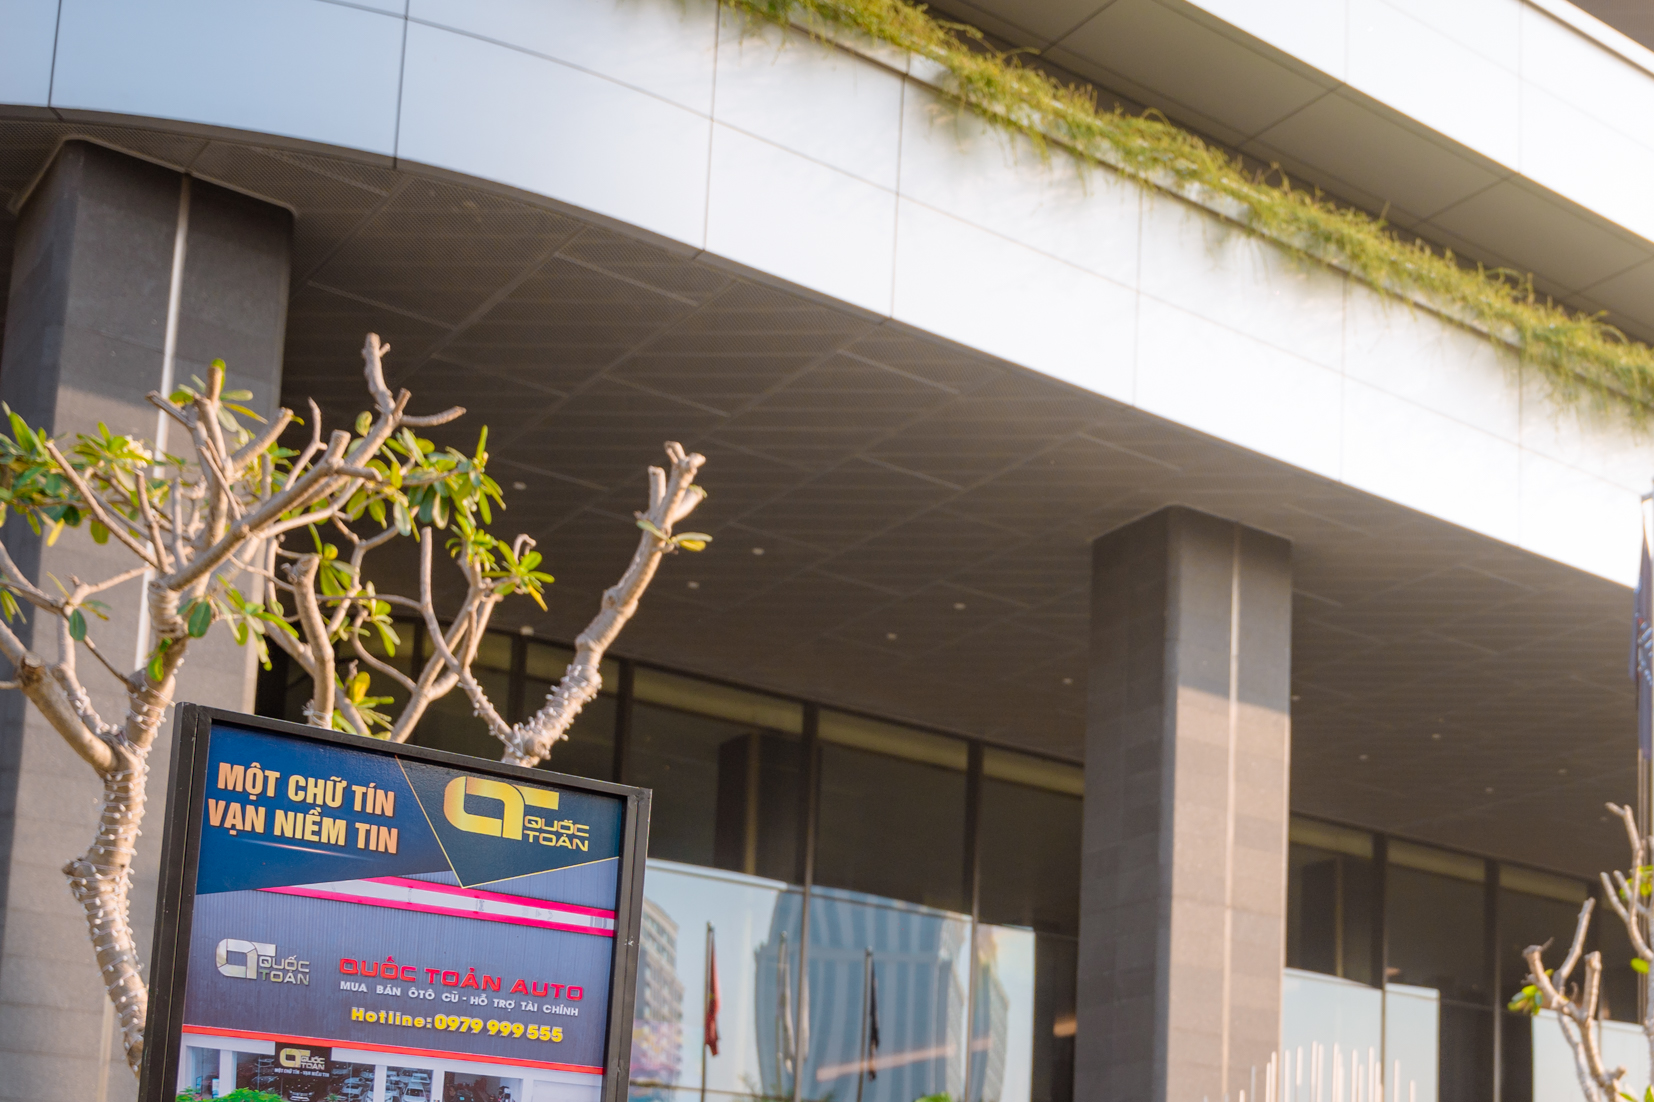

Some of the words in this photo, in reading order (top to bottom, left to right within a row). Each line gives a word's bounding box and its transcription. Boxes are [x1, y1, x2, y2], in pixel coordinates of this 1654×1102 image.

[217, 762, 280, 800] MỘT
[288, 775, 347, 807] CHỮ
[352, 783, 395, 817] TÍN
[208, 798, 266, 835] VẠN
[274, 807, 347, 845] NIỀM
[355, 822, 398, 854] TIN
[524, 816, 589, 837] QUỐC
[259, 955, 310, 972] QUỐC
[339, 955, 417, 981] QUỐC
[425, 968, 502, 992] TOẢN
[510, 979, 584, 1000] AUTO
[340, 981, 368, 992] MUA
[376, 985, 401, 996] BÁN
[408, 987, 435, 1000] ÔTÔ
[442, 991, 459, 1002] CŨ
[470, 994, 488, 1006] HỖ
[493, 998, 516, 1012] TRỢ
[521, 1000, 538, 1012] TÀI
[542, 1004, 579, 1016] CHÍNH
[351, 1007, 432, 1029] Hotline:
[434, 1014, 483, 1033] 0979
[487, 1019, 524, 1038] 999
[526, 1024, 563, 1042] 555
